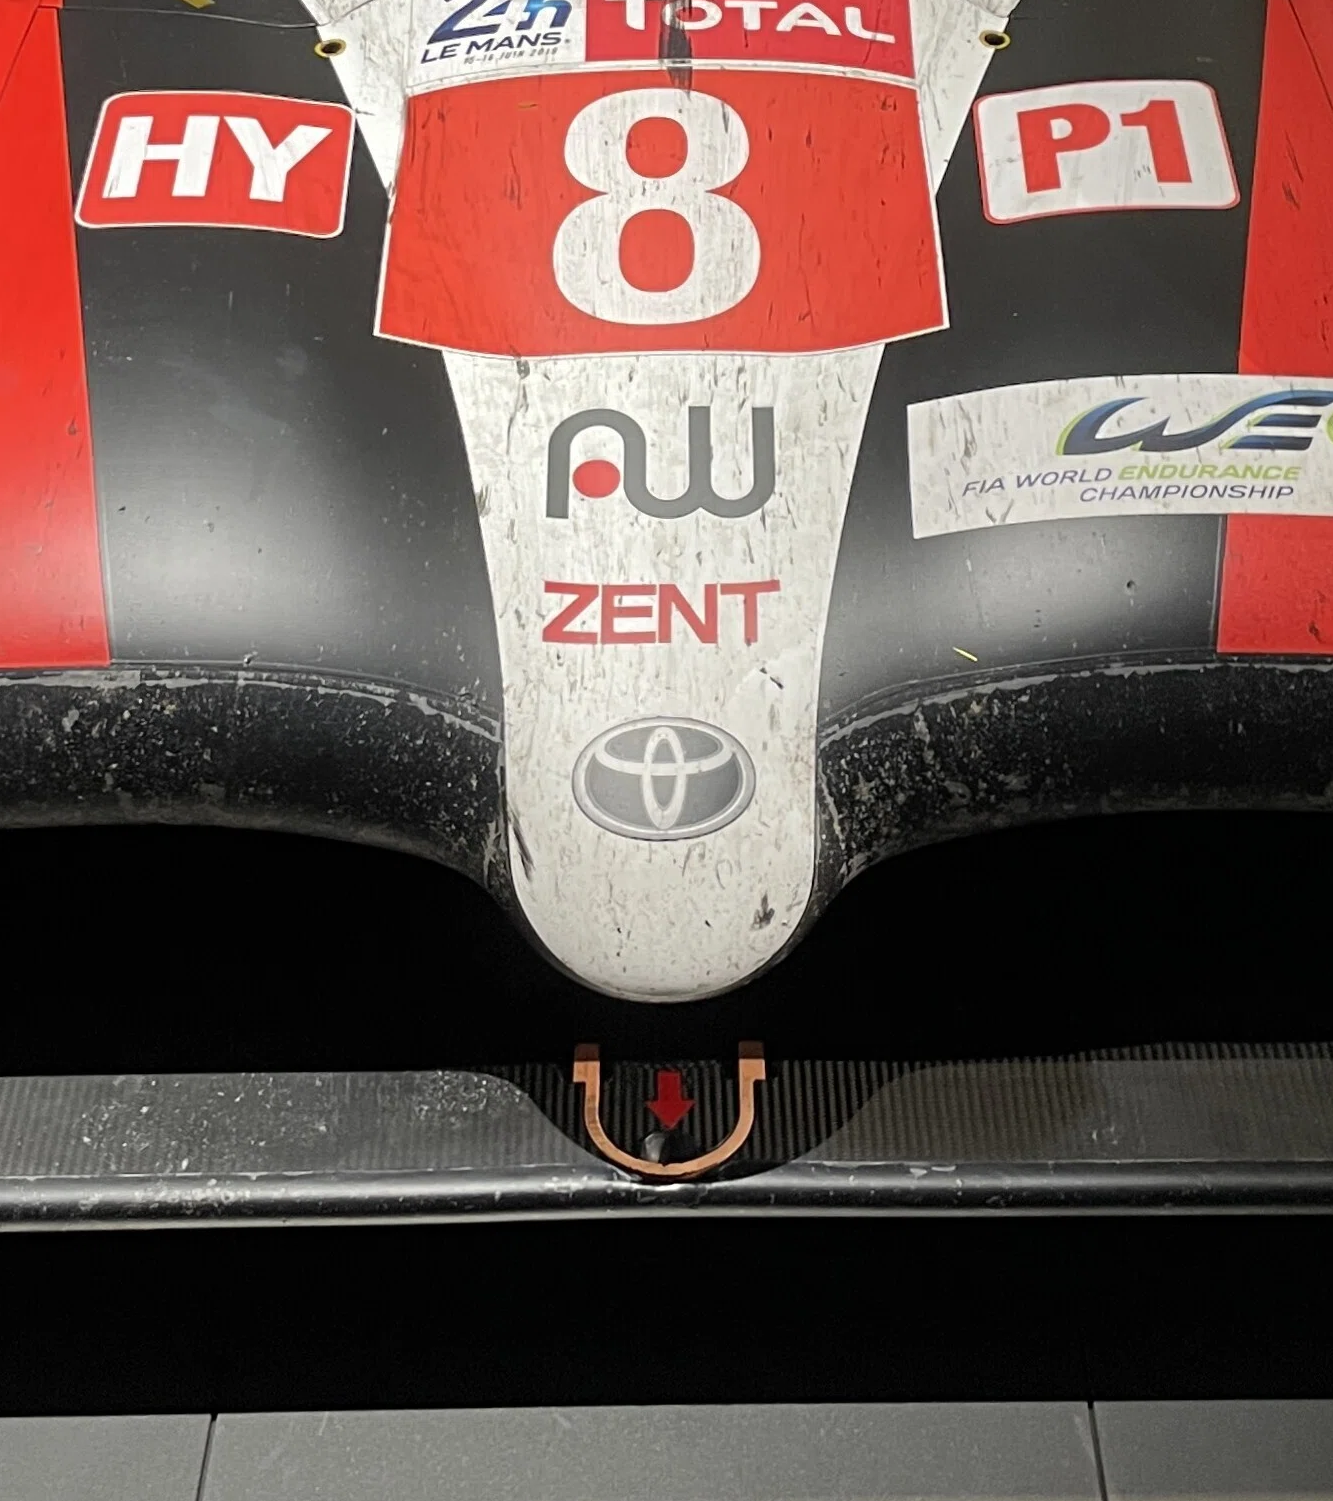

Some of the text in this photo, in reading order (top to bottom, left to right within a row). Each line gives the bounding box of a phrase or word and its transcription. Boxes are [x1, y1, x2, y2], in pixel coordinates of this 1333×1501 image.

[420, 31, 563, 64] LE MANS
[102, 114, 334, 203] HY
[1016, 98, 1193, 195] P1
[550, 86, 762, 327] 8
[962, 463, 1303, 498] FIA WORLD ENDURANCE
[1079, 483, 1296, 504] CHAMPIONSHIP
[542, 579, 783, 646] ZENT
